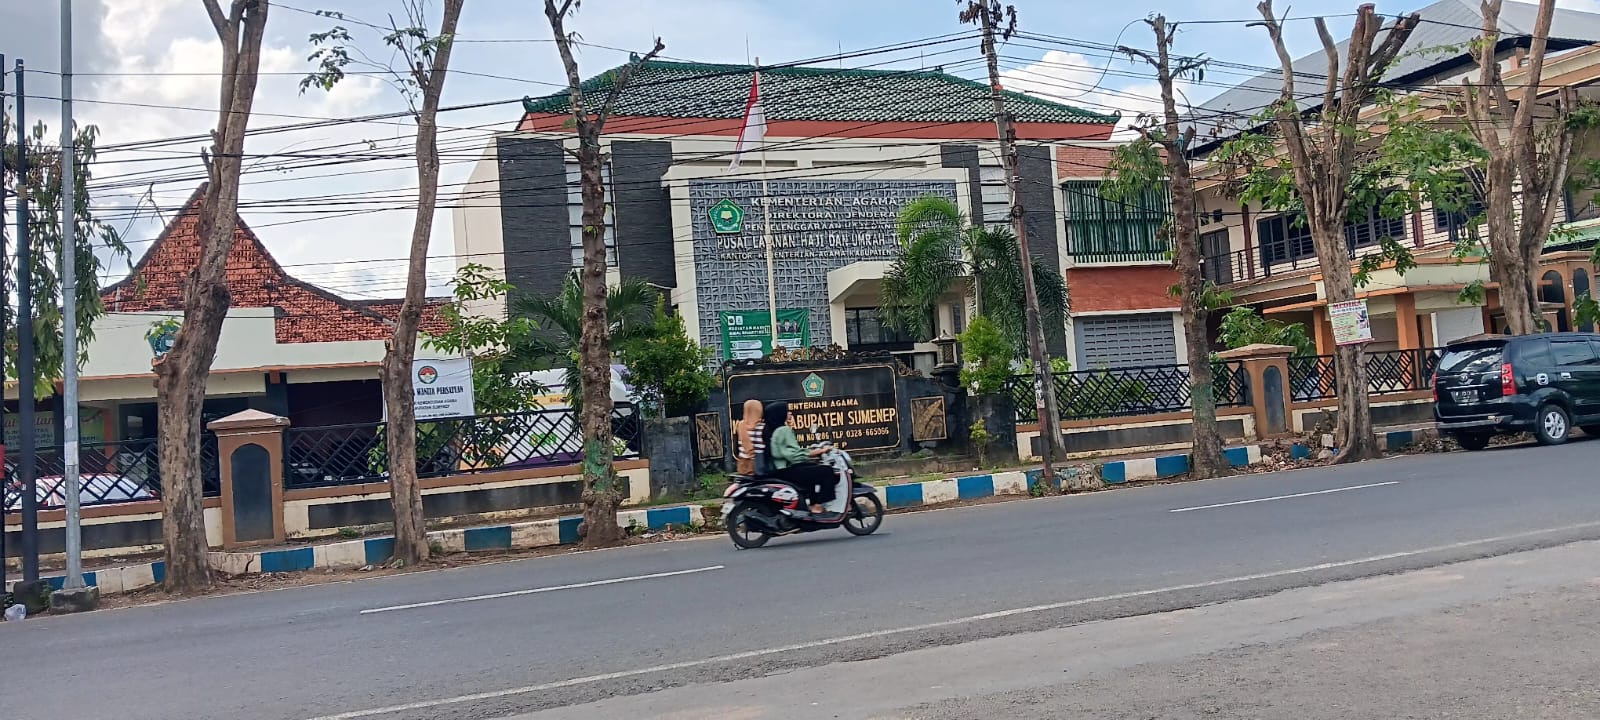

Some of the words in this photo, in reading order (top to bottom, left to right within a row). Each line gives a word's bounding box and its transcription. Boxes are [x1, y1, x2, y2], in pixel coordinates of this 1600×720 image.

[751, 197, 843, 206] KEMENTERIAN
[853, 197, 898, 206] AGAMA
[745, 222, 841, 231] PENELENGGARAAN
[717, 235, 748, 249] PUSAT
[801, 233, 825, 247] HAJI
[829, 233, 849, 247] DAN
[851, 232, 885, 246] UMRAH
[721, 251, 753, 260] KANTOR
[758, 250, 815, 259] KEENTERIAN
[819, 249, 846, 257] AGAMA
[849, 248, 892, 257] KABUPATEN
[788, 401, 828, 411] ENTERIAN
[830, 398, 859, 408] AGAMA
[790, 411, 844, 430] ABUPATEN
[848, 407, 896, 425] SUMENEP
[832, 430, 844, 439] TLP
